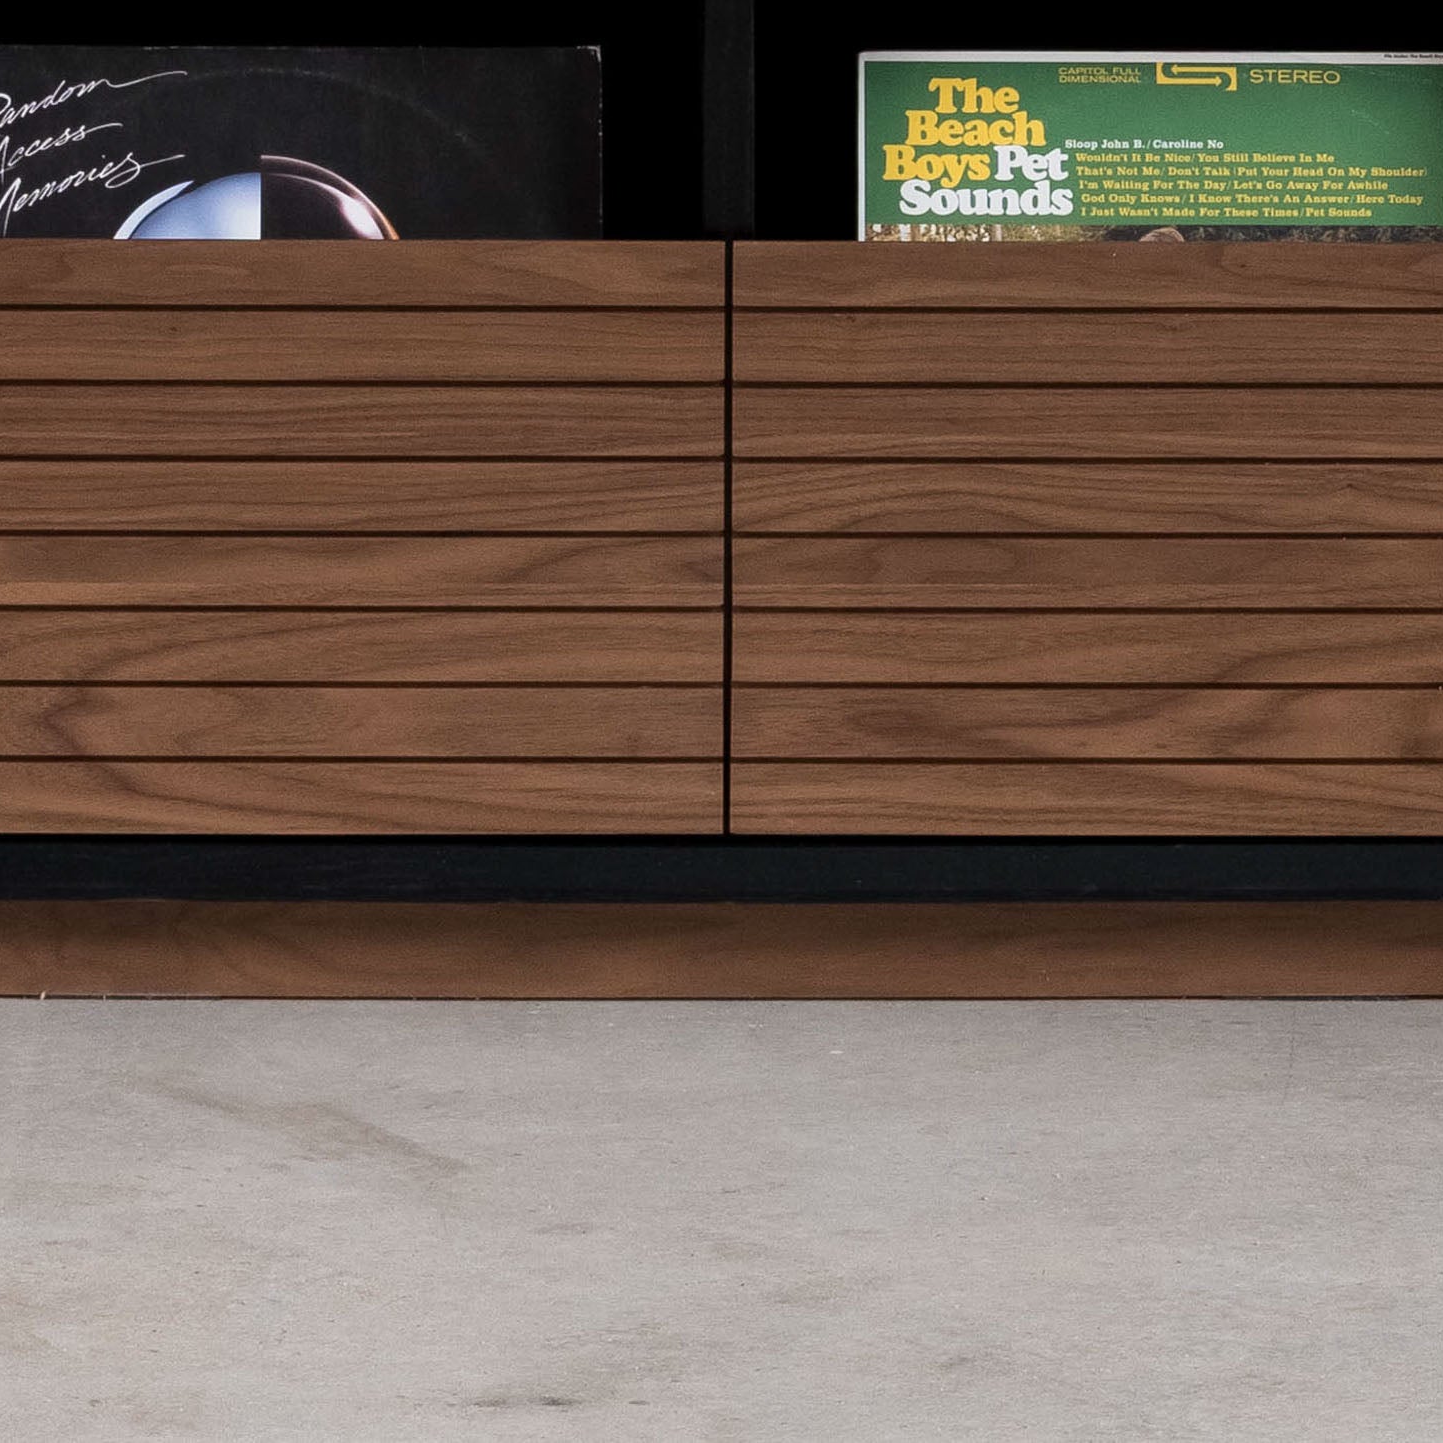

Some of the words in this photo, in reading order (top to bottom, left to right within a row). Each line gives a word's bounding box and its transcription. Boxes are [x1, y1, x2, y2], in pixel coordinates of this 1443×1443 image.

[1058, 67, 1108, 75] CAPITOL
[1113, 67, 1142, 75] FULL
[1058, 75, 1142, 84] DIMENSIONAL
[1249, 70, 1341, 84] STEREO
[928, 77, 1020, 114] The
[905, 109, 1047, 146] Beach
[1065, 139, 1098, 149] Sloop
[1101, 139, 1130, 149] John
[1207, 139, 1224, 149] No
[1075, 153, 1128, 163] Wouldn't
[1131, 153, 1141, 163] It
[1145, 153, 1160, 163] Be
[1197, 153, 1220, 163] You
[1223, 153, 1248, 163] Still
[1252, 153, 1296, 163] Believe
[1299, 153, 1312, 163] In
[1316, 153, 1335, 163] Me
[882, 144, 991, 188] Boys
[993, 145, 1069, 181] Pet
[1075, 167, 1113, 177] That's
[1117, 167, 1138, 177] Not
[1168, 167, 1200, 177] Don't
[1204, 167, 1230, 177] Talk
[1261, 167, 1289, 177] Your
[1293, 167, 1323, 177] Head
[1327, 167, 1345, 177] On
[1348, 167, 1367, 177] My
[1079, 181, 1099, 190] I'm
[1102, 181, 1150, 190] Waiting
[1153, 181, 1173, 190] For
[1176, 181, 1200, 190] The
[1233, 181, 1262, 190] Let's
[1266, 181, 1283, 190] Go
[1286, 181, 1319, 190] Away
[1322, 181, 1343, 190] For
[1347, 181, 1389, 190] Awhile
[899, 179, 1074, 216] Sounds
[1081, 194, 1105, 204] God
[1108, 194, 1136, 204] Only
[1198, 194, 1232, 204] Know
[1235, 194, 1279, 204] There's
[1283, 194, 1300, 204] An
[1387, 194, 1424, 204] Today
[1089, 208, 1114, 217] Just
[1118, 208, 1158, 217] Wasn't
[1162, 208, 1195, 217] Made
[1199, 208, 1220, 217] For
[1223, 208, 1258, 217] These
[1328, 208, 1372, 217] Sounds
